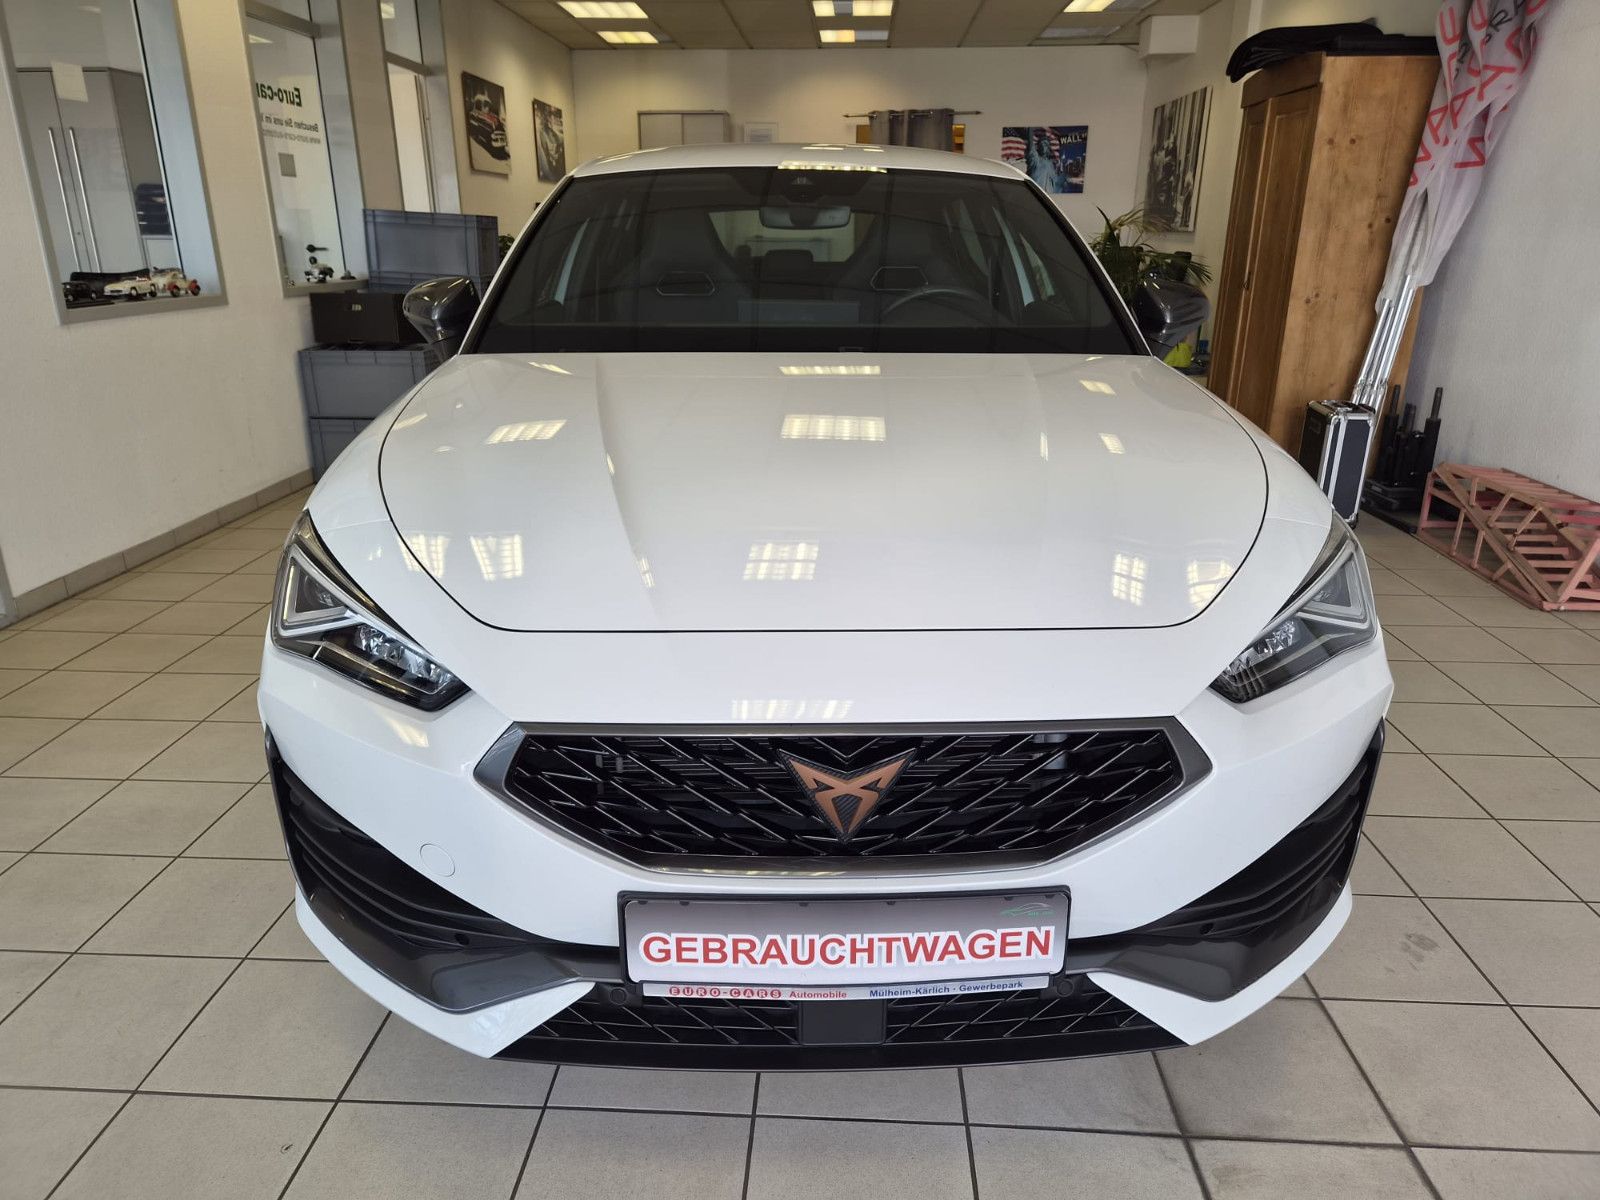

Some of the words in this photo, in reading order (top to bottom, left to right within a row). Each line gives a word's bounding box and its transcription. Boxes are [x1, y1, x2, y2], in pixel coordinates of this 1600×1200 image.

[1060, 132, 1082, 145] WALL
[642, 929, 1051, 966] GEBRAUCHTWAGEN
[669, 986, 782, 999] EURO-CARS
[789, 989, 847, 999] Automobile
[869, 984, 950, 998] Mülheim-Kärlich
[959, 980, 1024, 994] Gewerbepark
